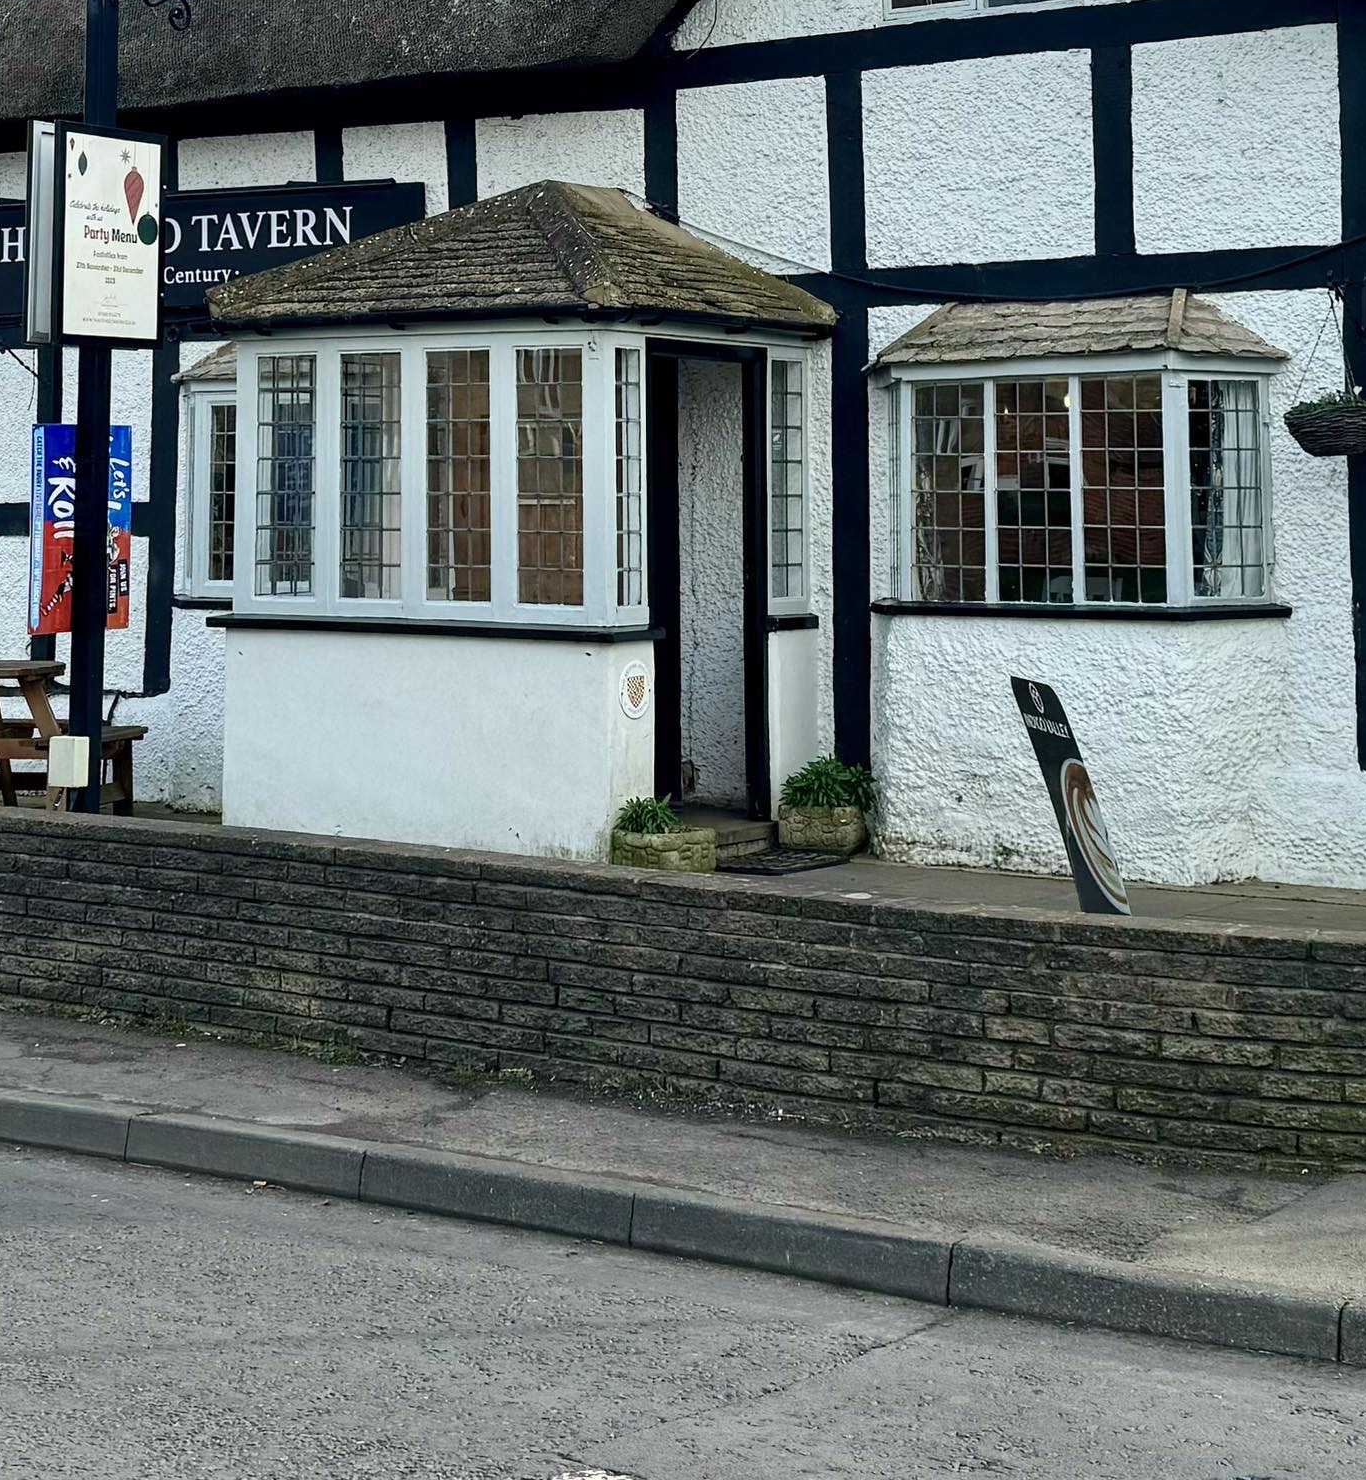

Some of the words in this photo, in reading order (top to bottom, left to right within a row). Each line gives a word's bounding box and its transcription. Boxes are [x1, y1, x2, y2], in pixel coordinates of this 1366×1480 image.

[84, 224, 110, 245] Party
[111, 228, 138, 244] Menu
[190, 206, 354, 252] TAVERN
[163, 266, 231, 285] Century
[109, 457, 130, 499] Let's
